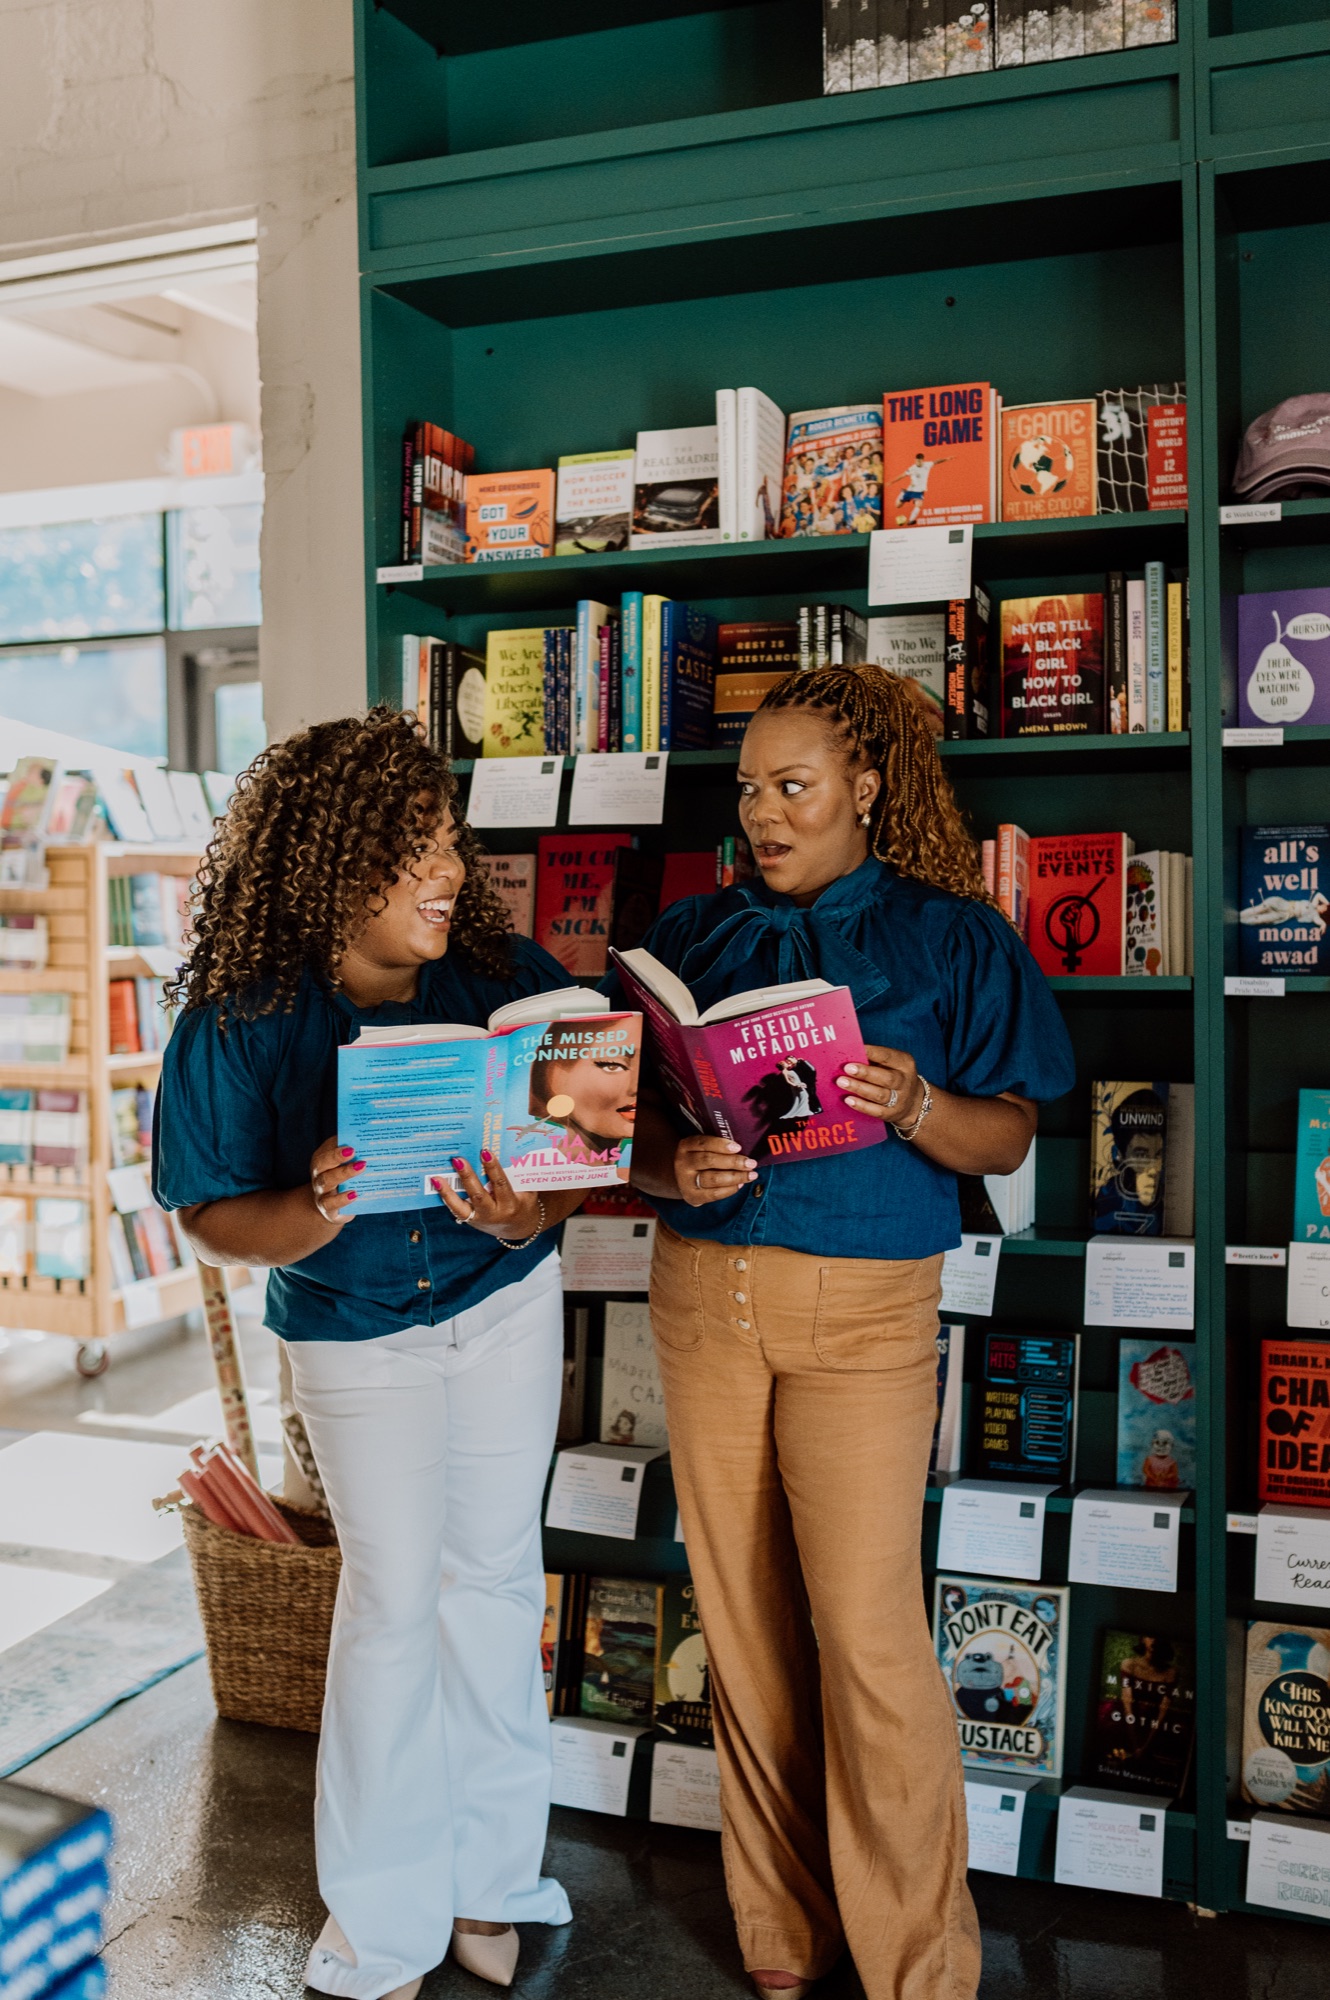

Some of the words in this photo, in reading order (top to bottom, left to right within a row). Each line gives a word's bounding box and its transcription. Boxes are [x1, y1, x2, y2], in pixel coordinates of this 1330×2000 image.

[888, 395, 924, 422] THE
[930, 388, 983, 418] LONG
[1163, 408, 1175, 416] THE
[808, 418, 833, 432] ROGER
[833, 412, 869, 428] BENNETT
[1017, 409, 1087, 438] GAME
[1153, 417, 1185, 428] HISTORY
[924, 417, 983, 447] GAME
[1168, 428, 1179, 436] THE
[1156, 438, 1183, 448] WORLD
[642, 456, 671, 468] REAL
[1164, 459, 1176, 472] 12
[1156, 474, 1183, 483] SOCCER
[1152, 485, 1188, 496] MATCHES
[481, 507, 505, 520] GOT
[1026, 499, 1048, 512] THE
[491, 527, 527, 541] YOUR
[477, 548, 541, 563] ANSWERS
[948, 614, 957, 636] NIGHT
[956, 605, 965, 642] SURVIVED
[1011, 622, 1057, 636] NEVER
[1059, 620, 1092, 633] TELL
[1292, 623, 1330, 635] HURSTON
[736, 640, 767, 650] REST
[770, 639, 786, 649] IS
[890, 638, 917, 651] Who
[920, 637, 938, 650] We
[1021, 642, 1033, 654] A
[1035, 638, 1082, 652] BLACK
[499, 650, 518, 661] We
[523, 648, 542, 659] Are
[600, 637, 609, 670] PRETTY
[722, 653, 798, 665] RESISTANCE
[501, 664, 530, 677] Each
[676, 655, 715, 684] CASTE
[1035, 658, 1068, 671] GIRL
[1133, 661, 1142, 676] JOY
[1267, 658, 1292, 669] THEIR
[661, 665, 669, 693] TRAUMA
[956, 663, 965, 689] JULIAN
[1022, 677, 1059, 690] HOW
[1061, 674, 1082, 688] TO
[1256, 672, 1277, 682] EYES
[1279, 669, 1303, 681] WERE
[491, 681, 534, 694] Other's
[1133, 679, 1142, 704] JAMES
[1258, 682, 1301, 694] WATCHING
[496, 698, 545, 710] Liberati
[956, 690, 965, 716] BRAVE
[1012, 695, 1058, 710] BLACK
[1061, 692, 1094, 706] GIRL
[1270, 696, 1289, 706] GOD
[599, 694, 608, 740] BROOKINS
[661, 704, 669, 727] CASTE
[1018, 723, 1050, 734] AMENA
[1053, 722, 1088, 732] BROWN
[1038, 848, 1115, 862] INCLUSIVE
[1263, 840, 1320, 864] all's
[1037, 861, 1115, 877] EVENTS
[562, 873, 601, 889] ME.
[1263, 867, 1319, 891] well
[550, 918, 610, 936] SICK
[1258, 926, 1322, 942] mona
[1261, 945, 1319, 966] awad
[1239, 979, 1270, 987] Disability
[740, 1011, 816, 1044] FREIDA
[521, 1033, 554, 1049] THE
[559, 1029, 629, 1045] MISSED
[513, 1043, 636, 1067] CONNECTION
[484, 1046, 497, 1098] WILLIAMS
[496, 1061, 506, 1078] TIA
[693, 1059, 724, 1100] DIVORCE
[795, 1119, 816, 1128] THE
[1119, 1113, 1164, 1126] UNWIND
[548, 1133, 586, 1149] TIA
[509, 1147, 622, 1169] WILLIAMS
[520, 1176, 549, 1185] SEVEN
[551, 1174, 574, 1184] DAYS
[574, 1174, 585, 1182] IN
[586, 1172, 609, 1181] JUNE
[989, 1352, 1017, 1370] HITS
[1268, 1353, 1309, 1368] IBRAM
[1310, 1356, 1323, 1369] X.
[984, 1391, 1020, 1406] WRITERS
[1267, 1375, 1330, 1408] CHA
[984, 1406, 1017, 1420] PLAYING
[984, 1421, 1008, 1436] VIDEO
[1266, 1408, 1316, 1439] OF
[983, 1437, 1009, 1451] GAMES
[1266, 1439, 1330, 1473] IDEA
[1267, 1473, 1285, 1484] THE
[1286, 1475, 1326, 1488] ORIGINS
[947, 1602, 1009, 1650] DON'T
[1010, 1608, 1052, 1655] EAT
[1106, 1674, 1194, 1700] MEXICAN
[1279, 1681, 1322, 1703] THIS
[1264, 1697, 1330, 1723] KINGDO
[1111, 1711, 1183, 1734] GOTHIC
[1269, 1715, 1303, 1733] WILL
[957, 1722, 1036, 1754] USTACE
[1273, 1731, 1304, 1749] KILL
